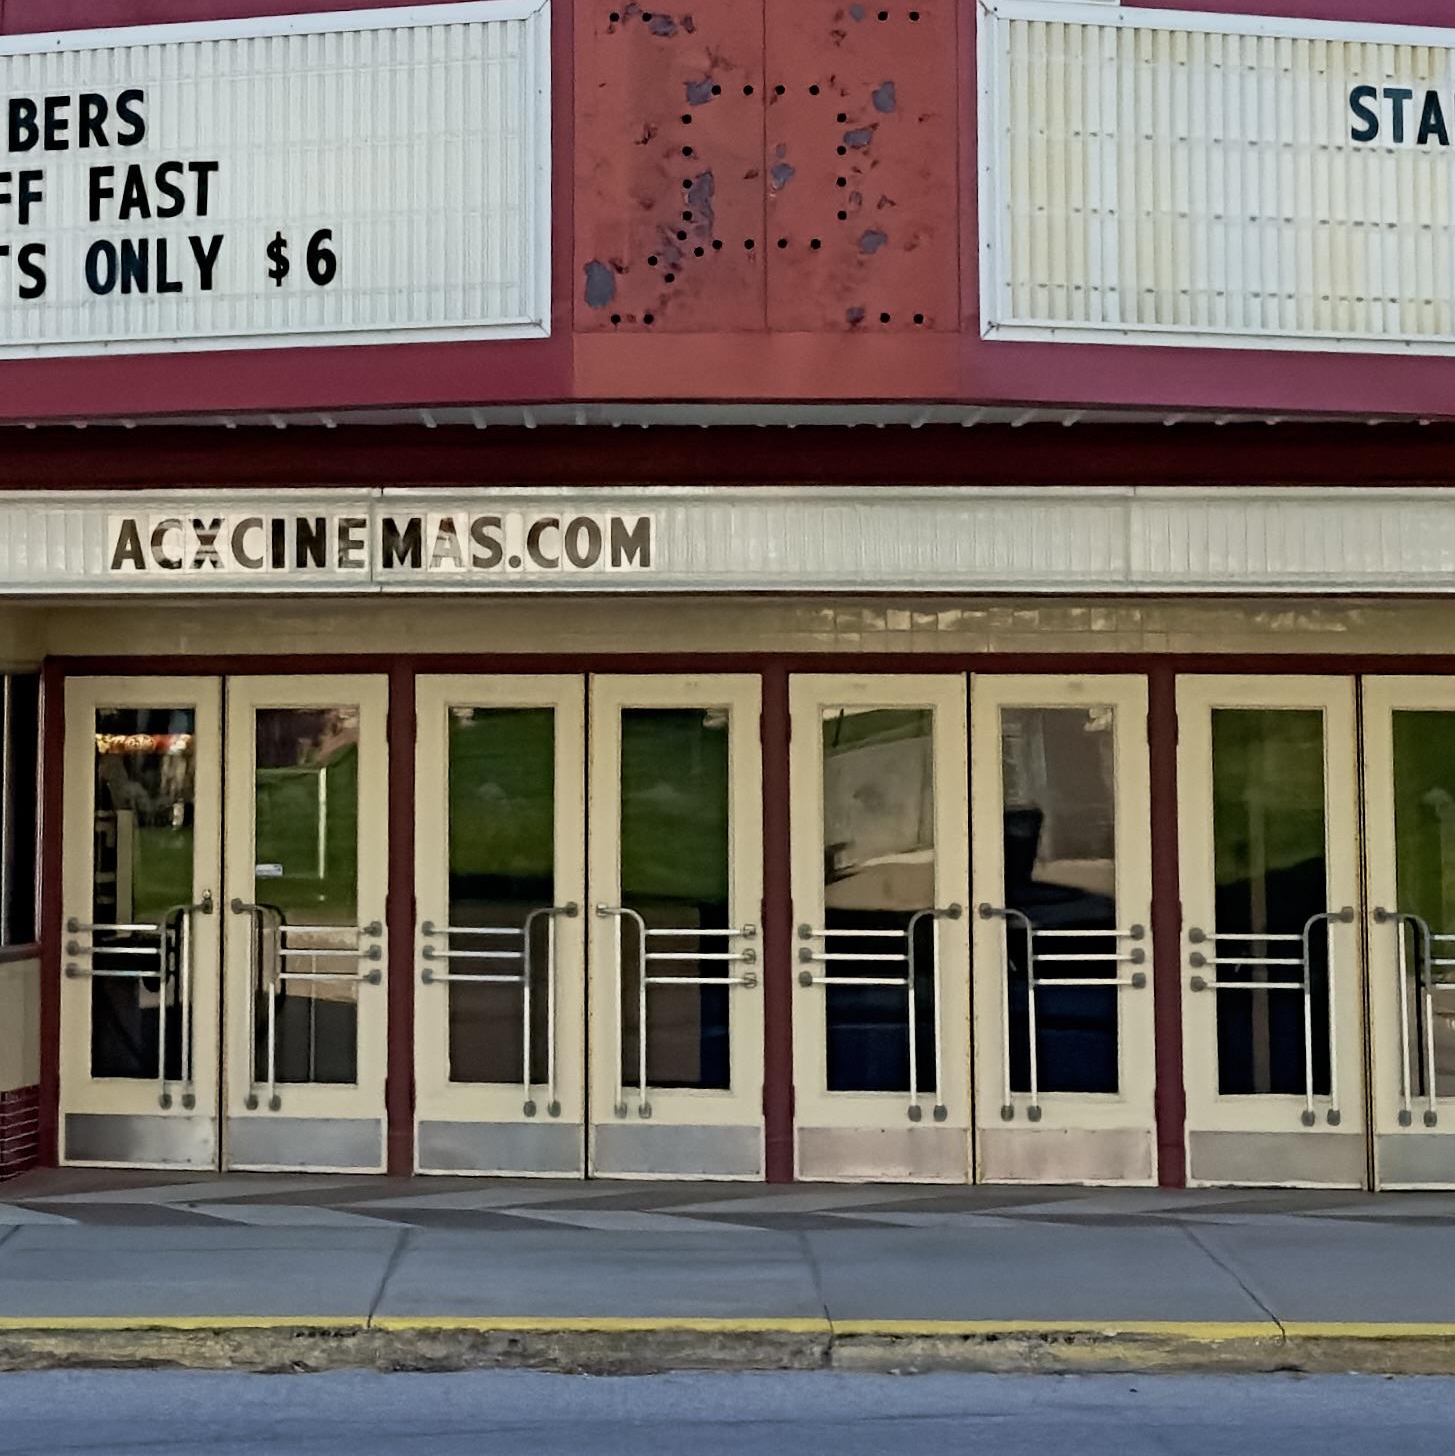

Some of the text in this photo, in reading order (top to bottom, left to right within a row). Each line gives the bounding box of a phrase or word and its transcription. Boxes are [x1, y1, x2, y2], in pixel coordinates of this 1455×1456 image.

[88, 161, 220, 222] FAST
[85, 234, 225, 296] ONLY
[110, 516, 652, 572] ACXCINEMAS.COM
